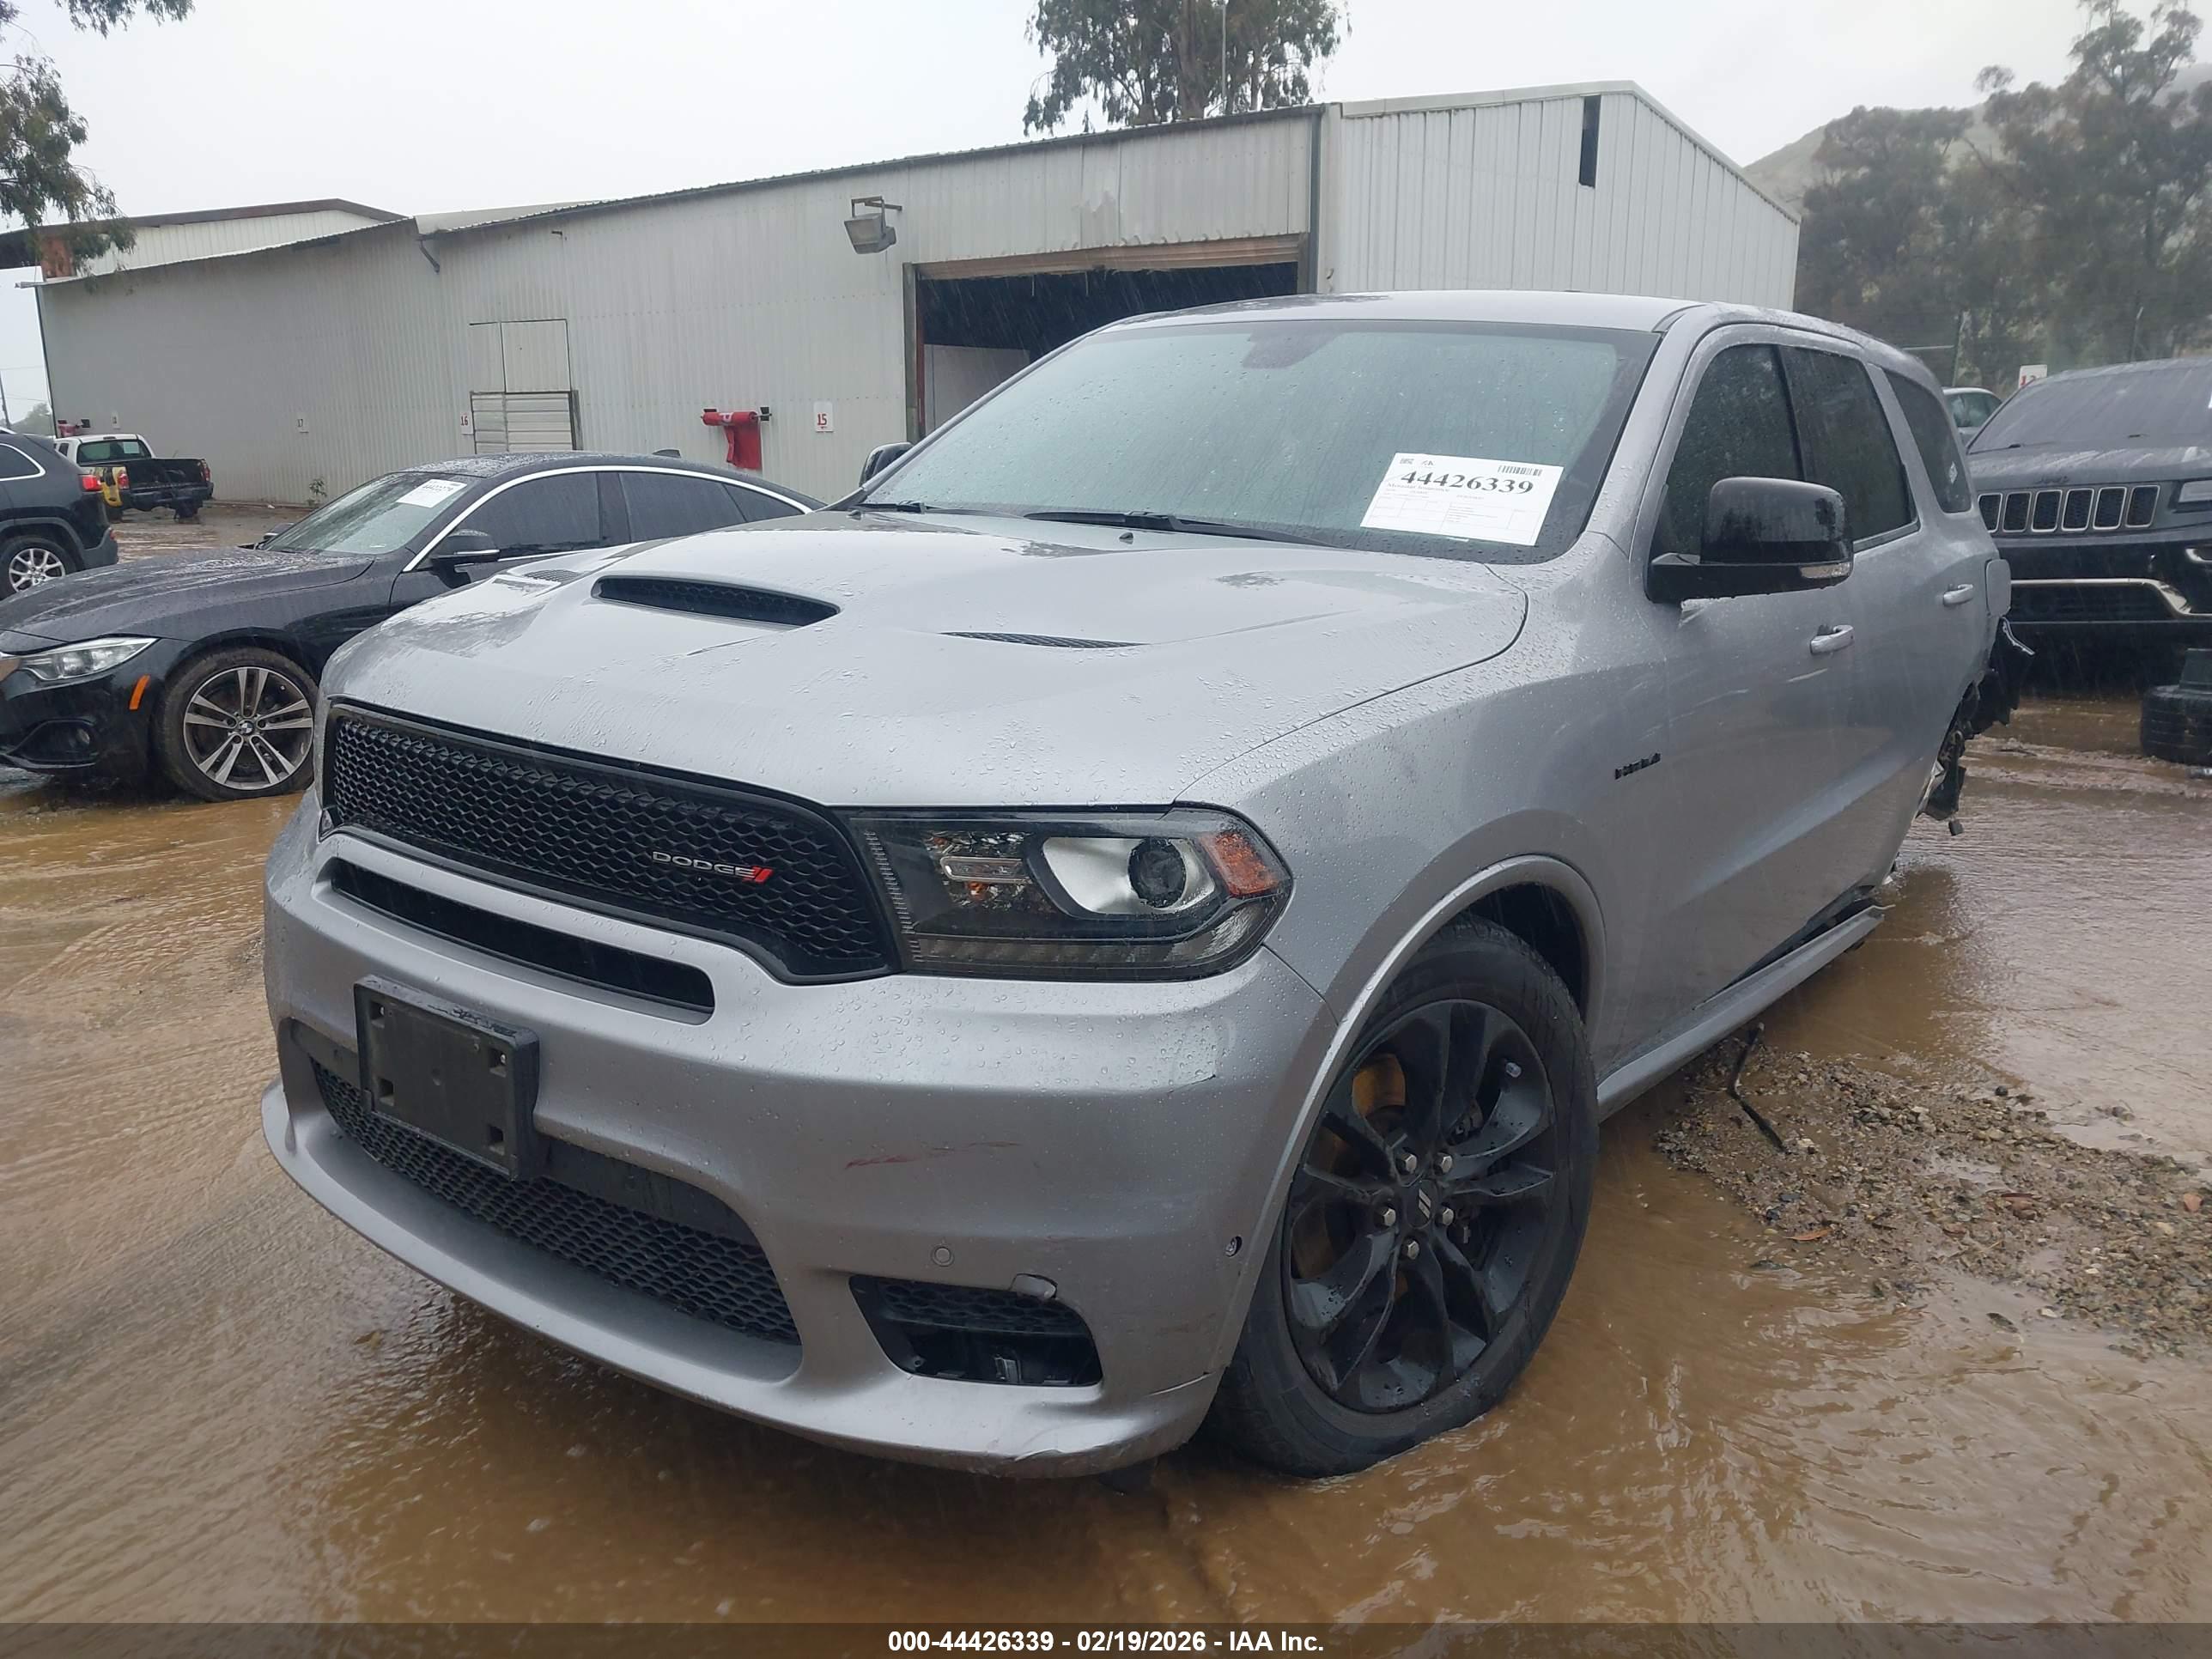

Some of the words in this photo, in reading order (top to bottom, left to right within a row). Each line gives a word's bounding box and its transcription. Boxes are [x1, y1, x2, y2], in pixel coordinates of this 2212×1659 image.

[460, 416, 469, 426] 16
[817, 413, 827, 426] 15
[1401, 471, 1534, 495] 44426339
[653, 851, 757, 878] DODGE
